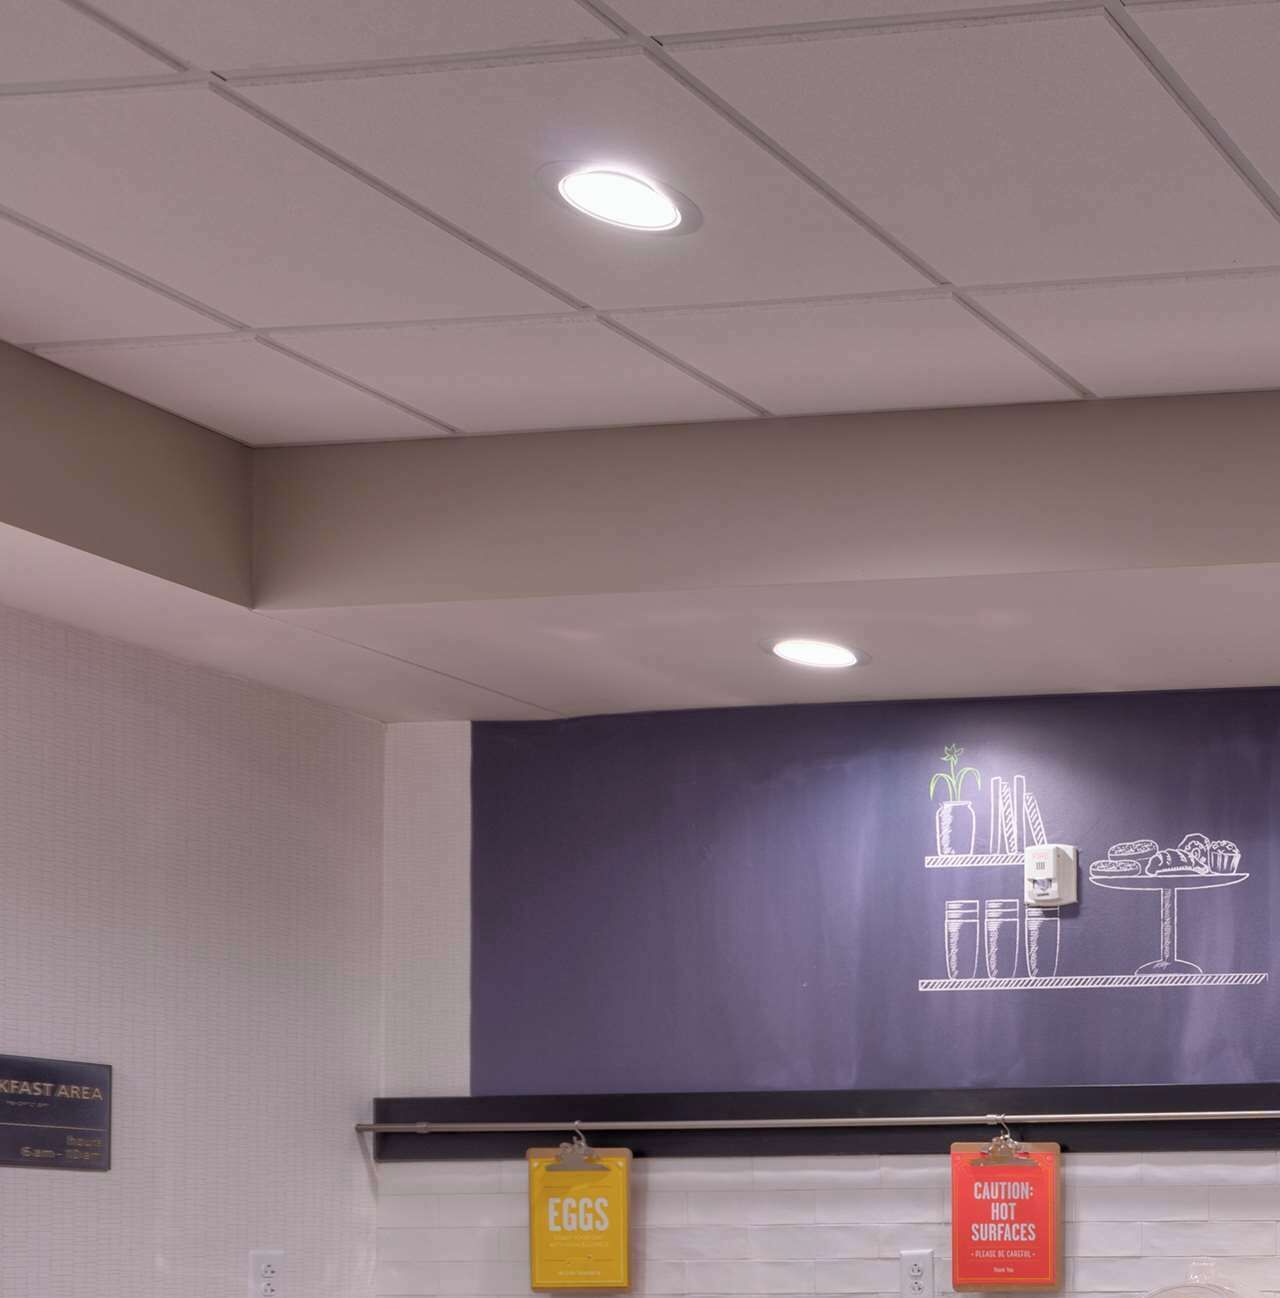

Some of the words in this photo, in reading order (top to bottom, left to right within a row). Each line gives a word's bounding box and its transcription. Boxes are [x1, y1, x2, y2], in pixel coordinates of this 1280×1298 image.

[54, 1084, 104, 1101] AREA
[973, 1181, 1034, 1200] CAUTION:
[547, 1196, 609, 1232] EGGS
[991, 1202, 1017, 1221] HOT
[971, 1223, 1036, 1242] SURFACES
